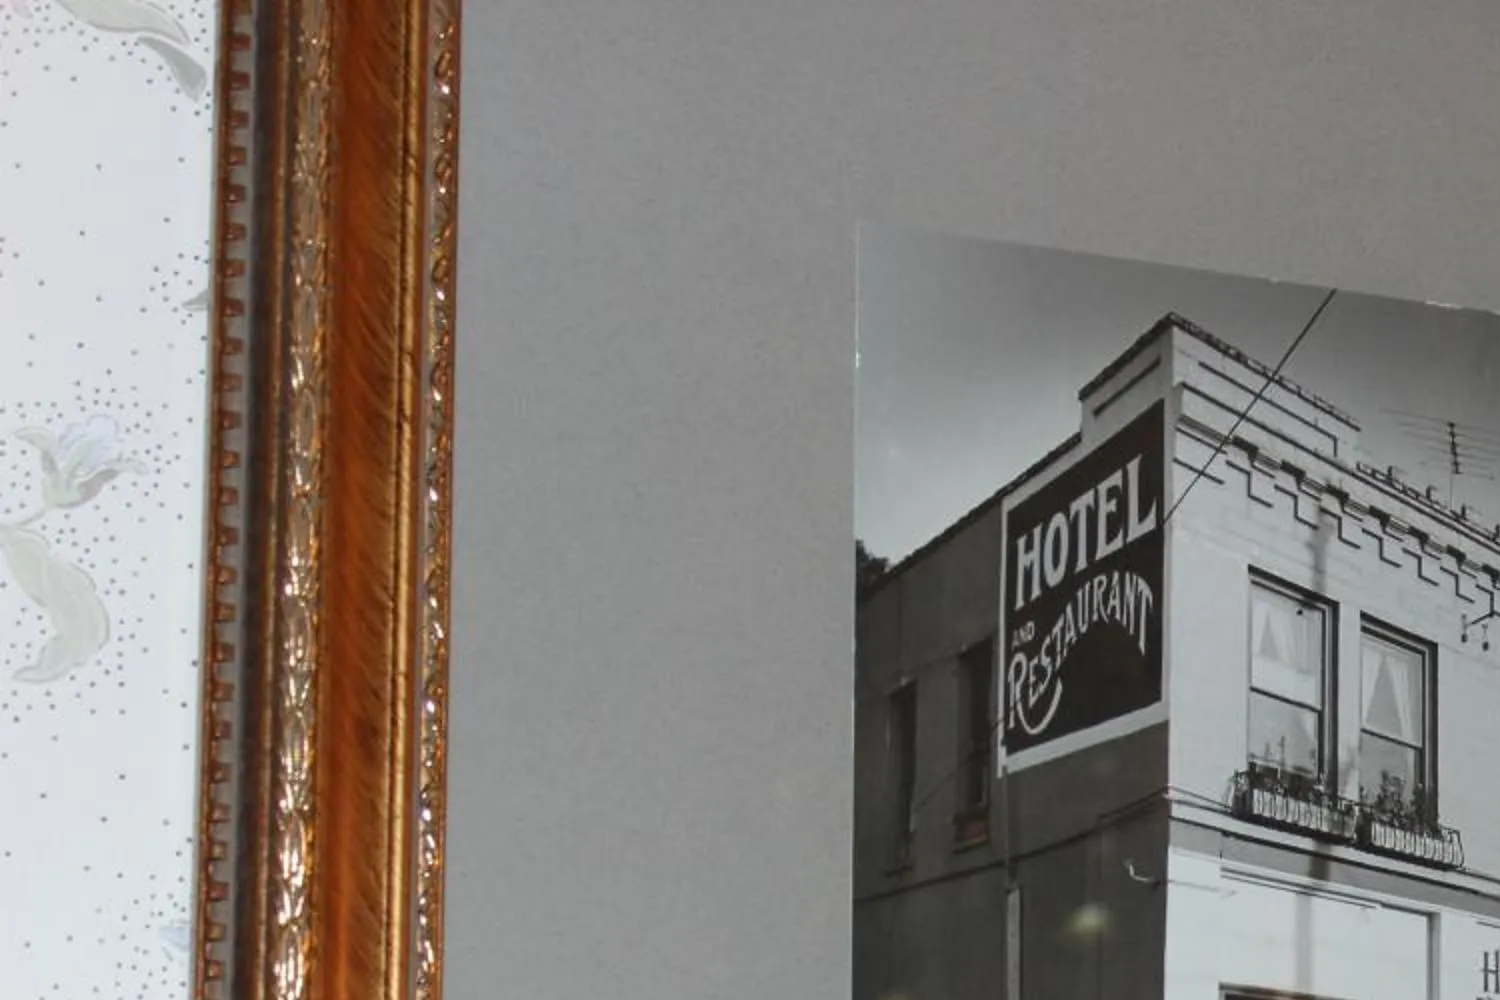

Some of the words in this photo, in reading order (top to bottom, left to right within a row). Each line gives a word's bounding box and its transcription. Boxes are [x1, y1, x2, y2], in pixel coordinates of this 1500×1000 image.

[1015, 454, 1157, 610] HOTEL
[1008, 570, 1153, 735] RESTAURANT
[1011, 621, 1036, 648] AND
